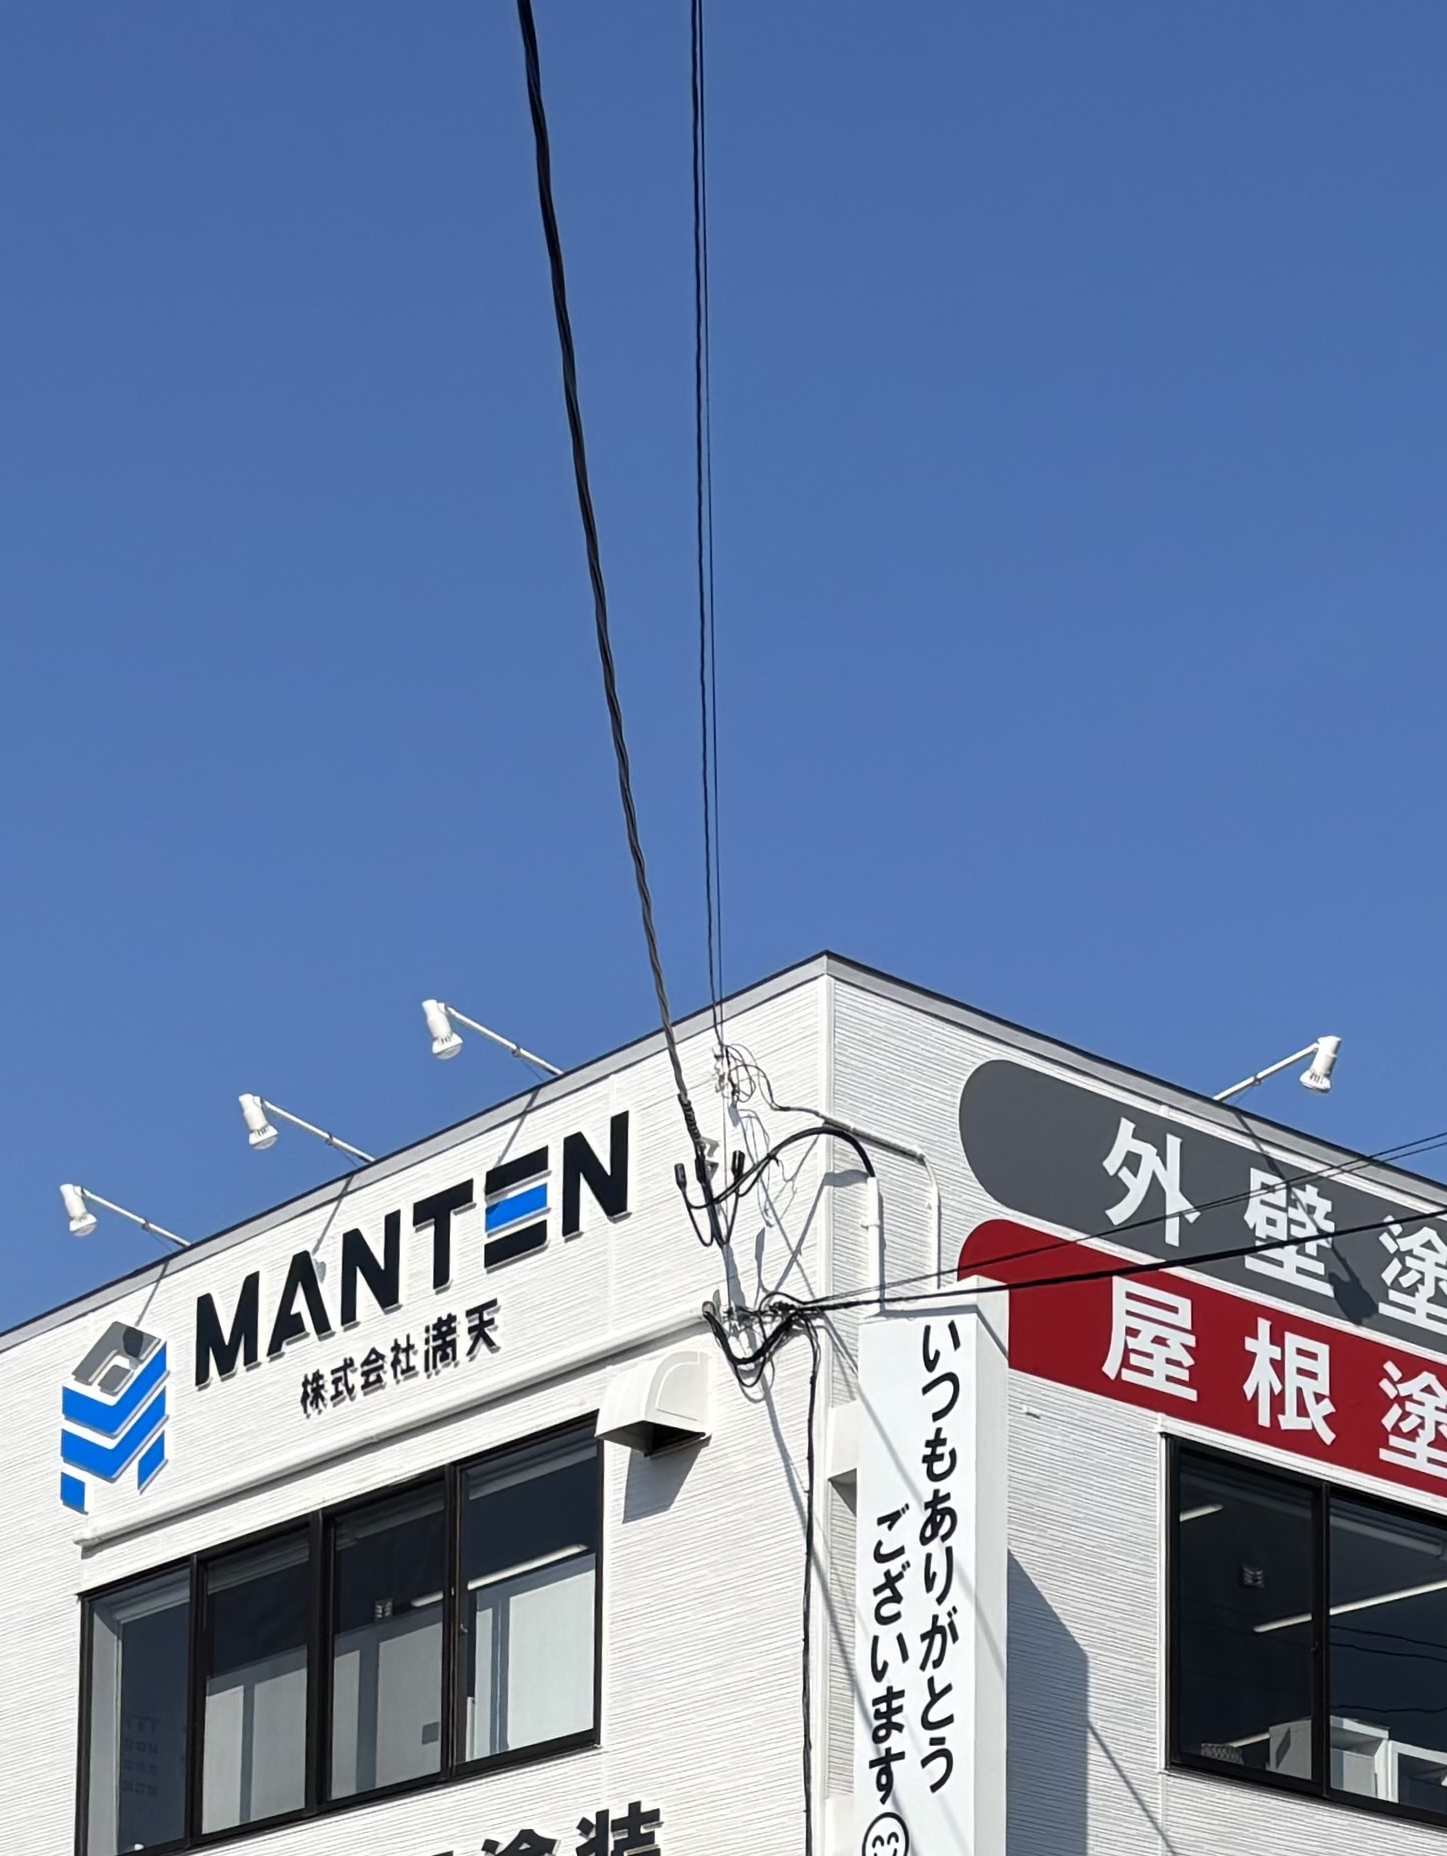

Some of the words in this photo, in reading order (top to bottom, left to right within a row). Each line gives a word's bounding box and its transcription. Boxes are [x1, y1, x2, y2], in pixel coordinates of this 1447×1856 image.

[195, 1110, 630, 1388] MANTEN
[299, 1298, 499, 1416] 株式会社満天
[868, 1503, 911, 1805] ございます
[918, 1319, 961, 1794] いつもありがとう
